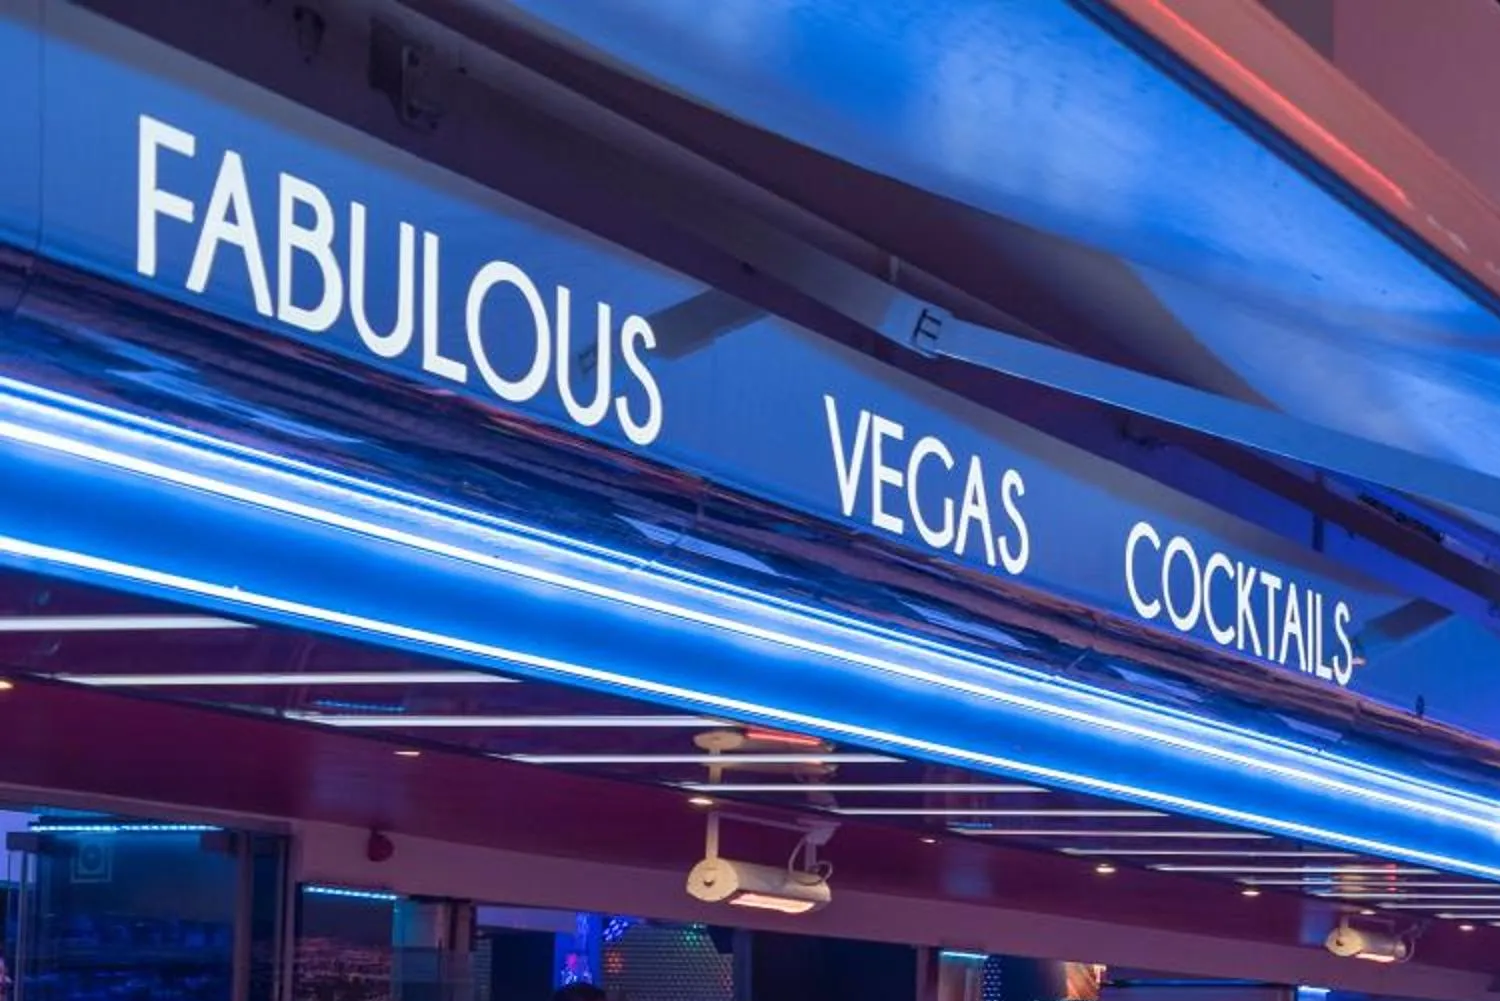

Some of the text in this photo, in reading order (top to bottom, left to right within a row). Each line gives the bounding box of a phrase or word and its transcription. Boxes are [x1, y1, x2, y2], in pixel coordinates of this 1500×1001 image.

[137, 114, 1354, 686] FABULOUS VEGAS COCKTAILS
